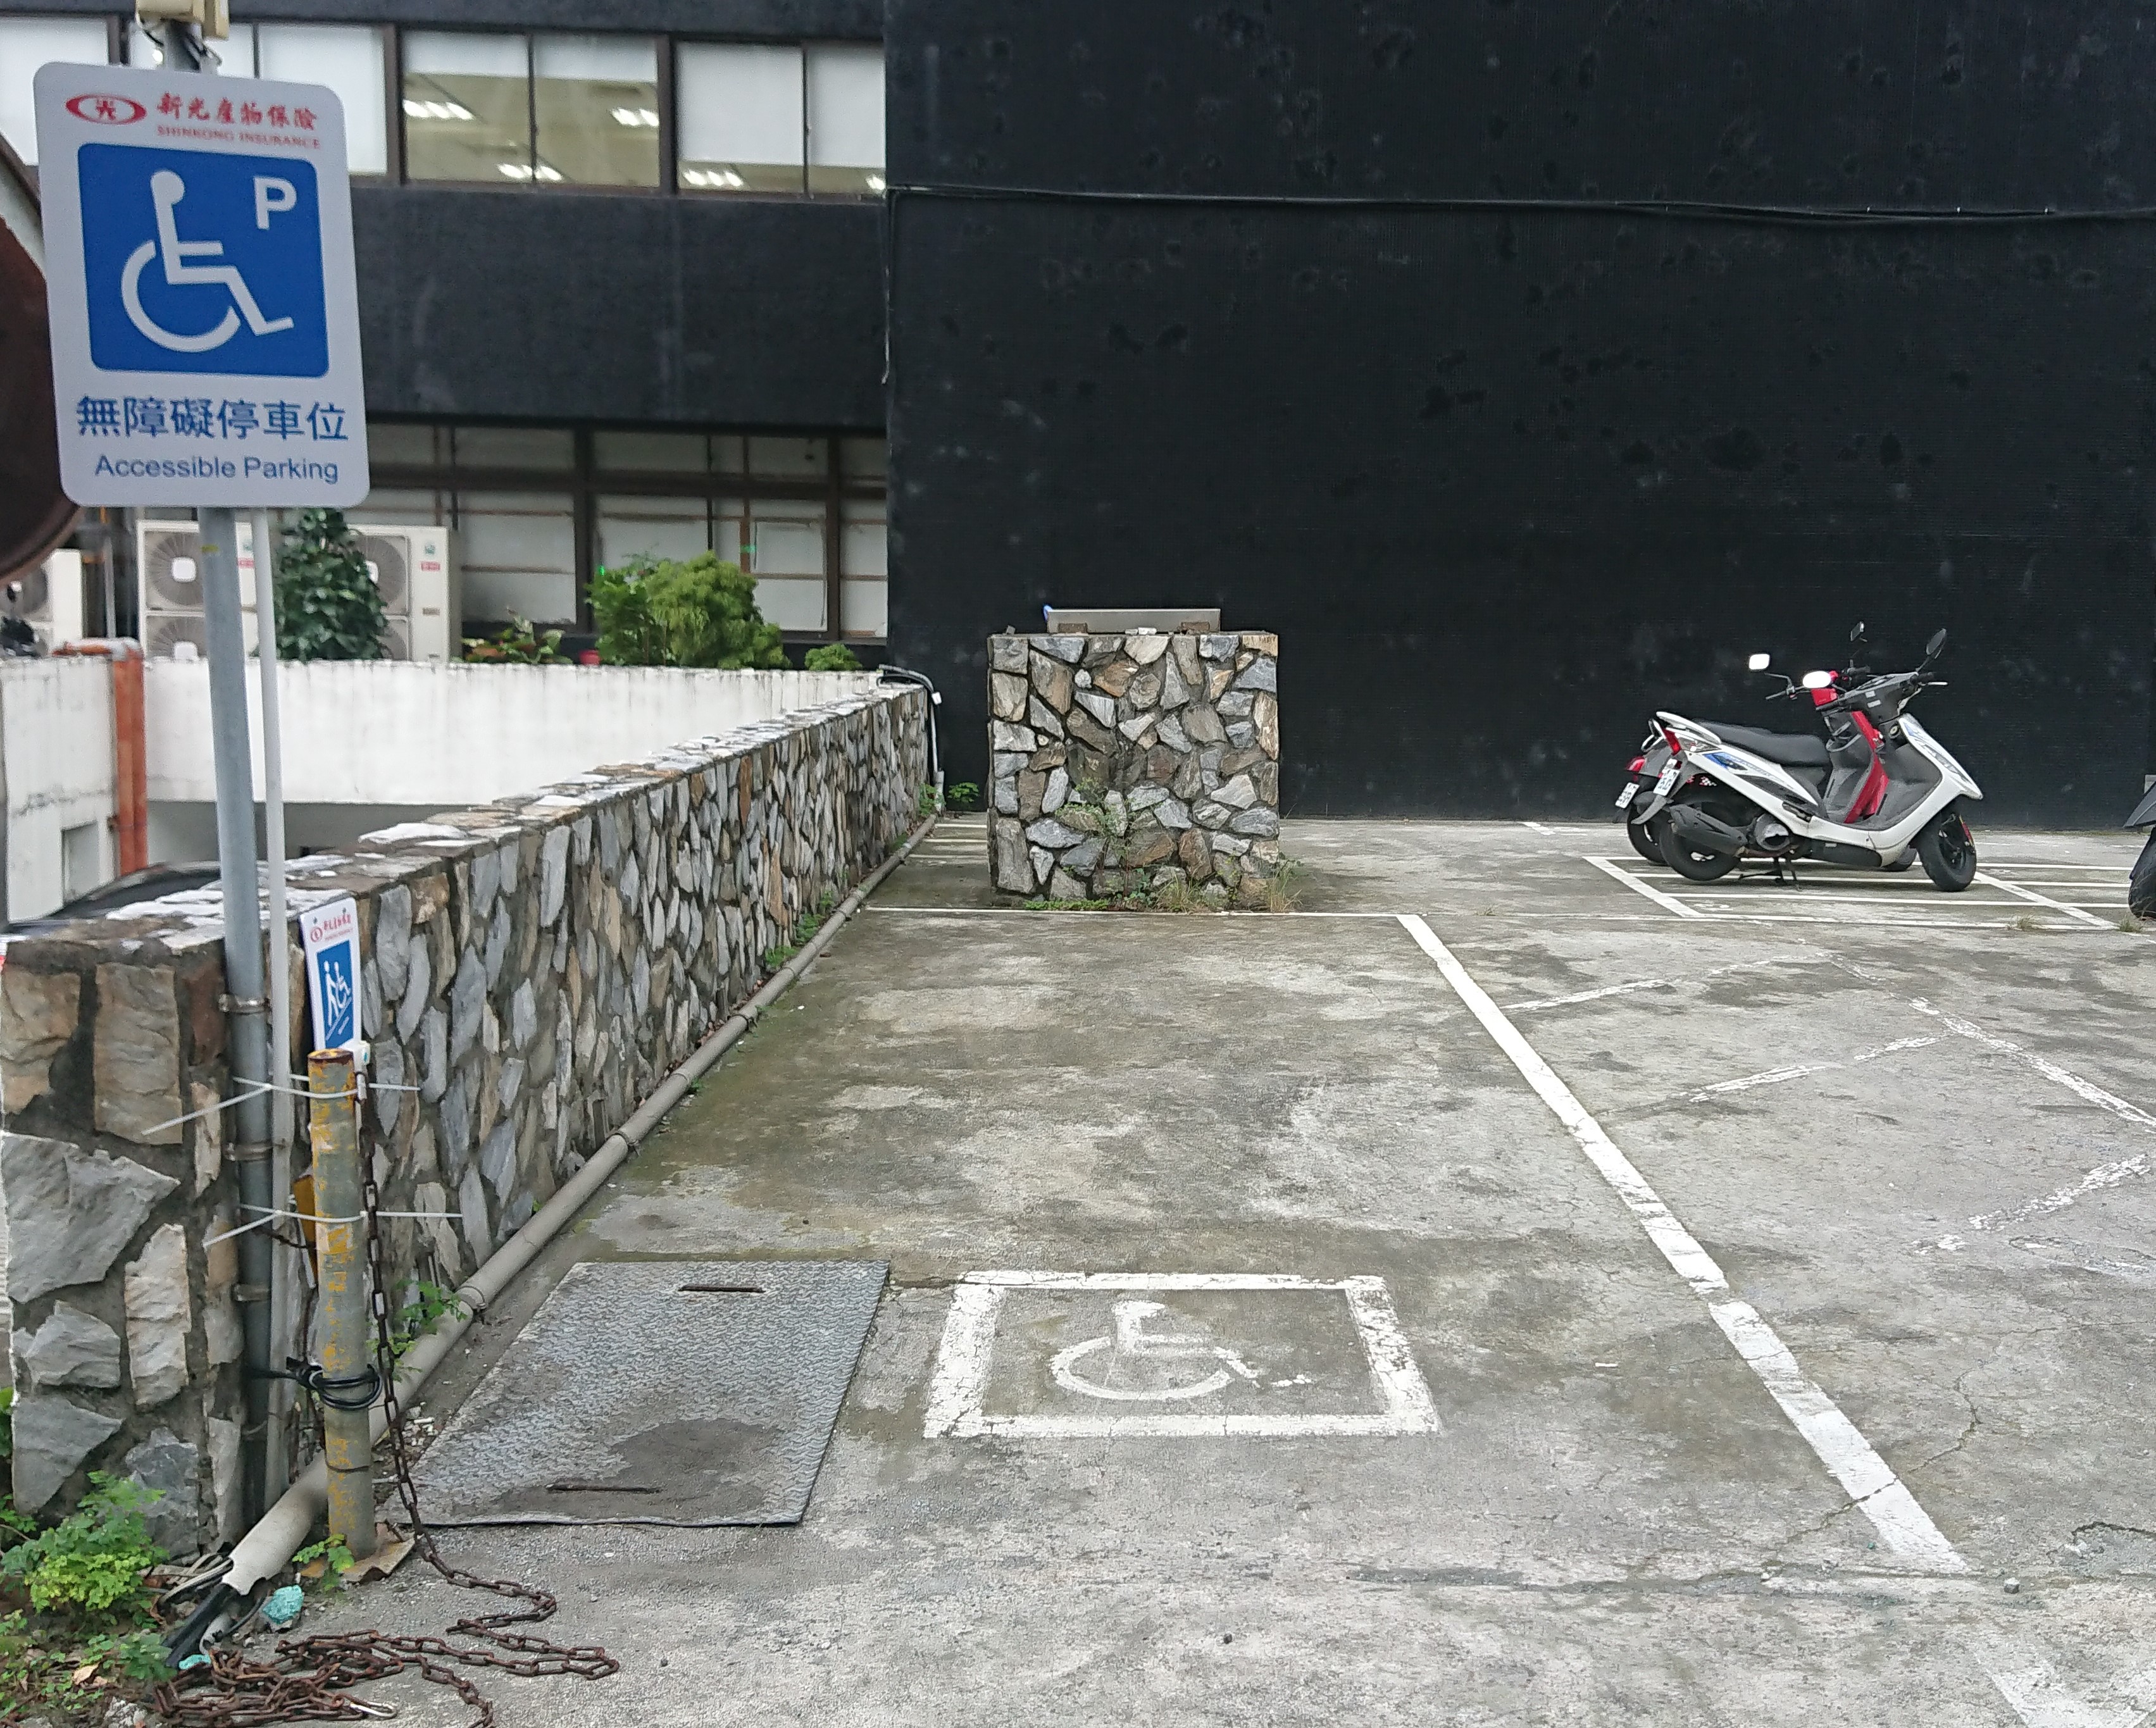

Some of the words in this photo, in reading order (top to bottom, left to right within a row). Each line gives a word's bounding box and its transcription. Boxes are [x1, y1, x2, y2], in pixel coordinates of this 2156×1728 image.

[239, 131, 320, 149] INSURANCE
[254, 177, 297, 229] P
[76, 395, 349, 441] 無障礙停車位
[94, 454, 236, 478] Accessible
[244, 456, 339, 485] Parking
